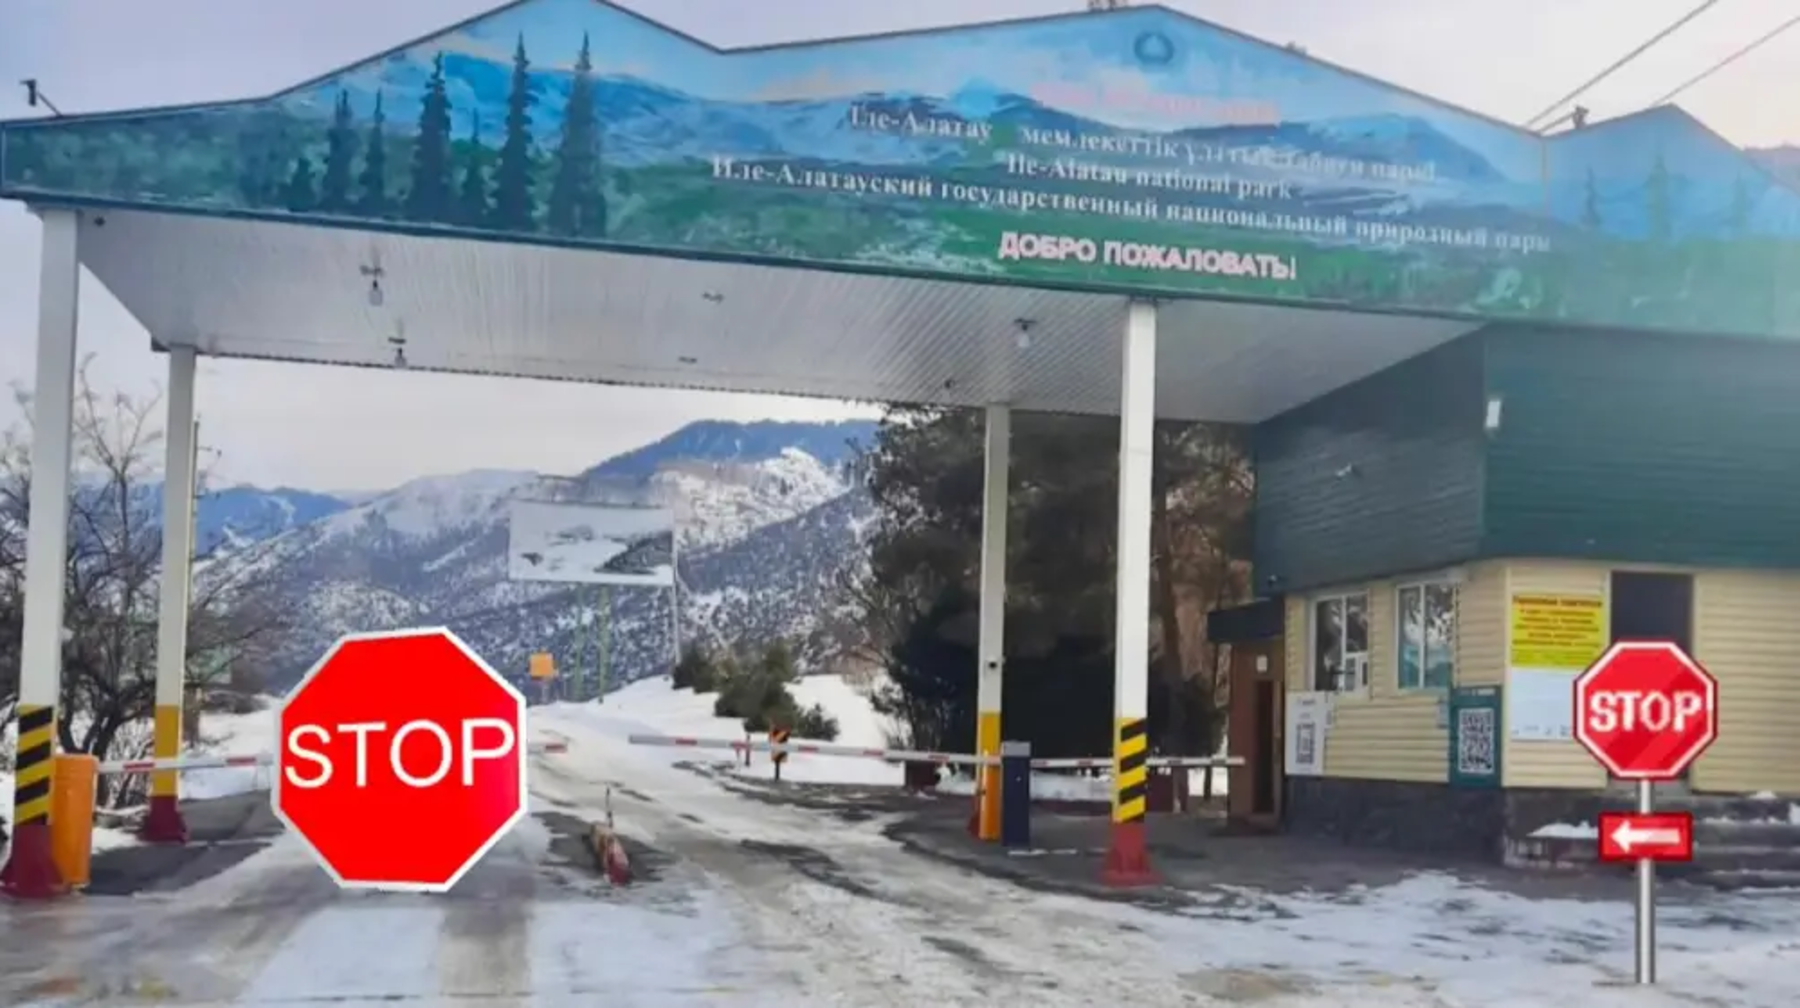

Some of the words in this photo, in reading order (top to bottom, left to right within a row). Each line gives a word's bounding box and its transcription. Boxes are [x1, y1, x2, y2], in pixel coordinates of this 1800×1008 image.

[712, 156, 932, 197] Иле-Алатауский
[941, 180, 1158, 221] государственный
[1165, 204, 1348, 237] национальный
[1007, 152, 1128, 186] Ile-Alatau
[1136, 173, 1231, 196] national
[1237, 178, 1292, 201] park
[998, 231, 1097, 262] ДОБРО
[1103, 240, 1297, 280] ПОЖАЛОВАТЬ!
[1589, 690, 1702, 733] STOP
[285, 717, 516, 789] STOP
